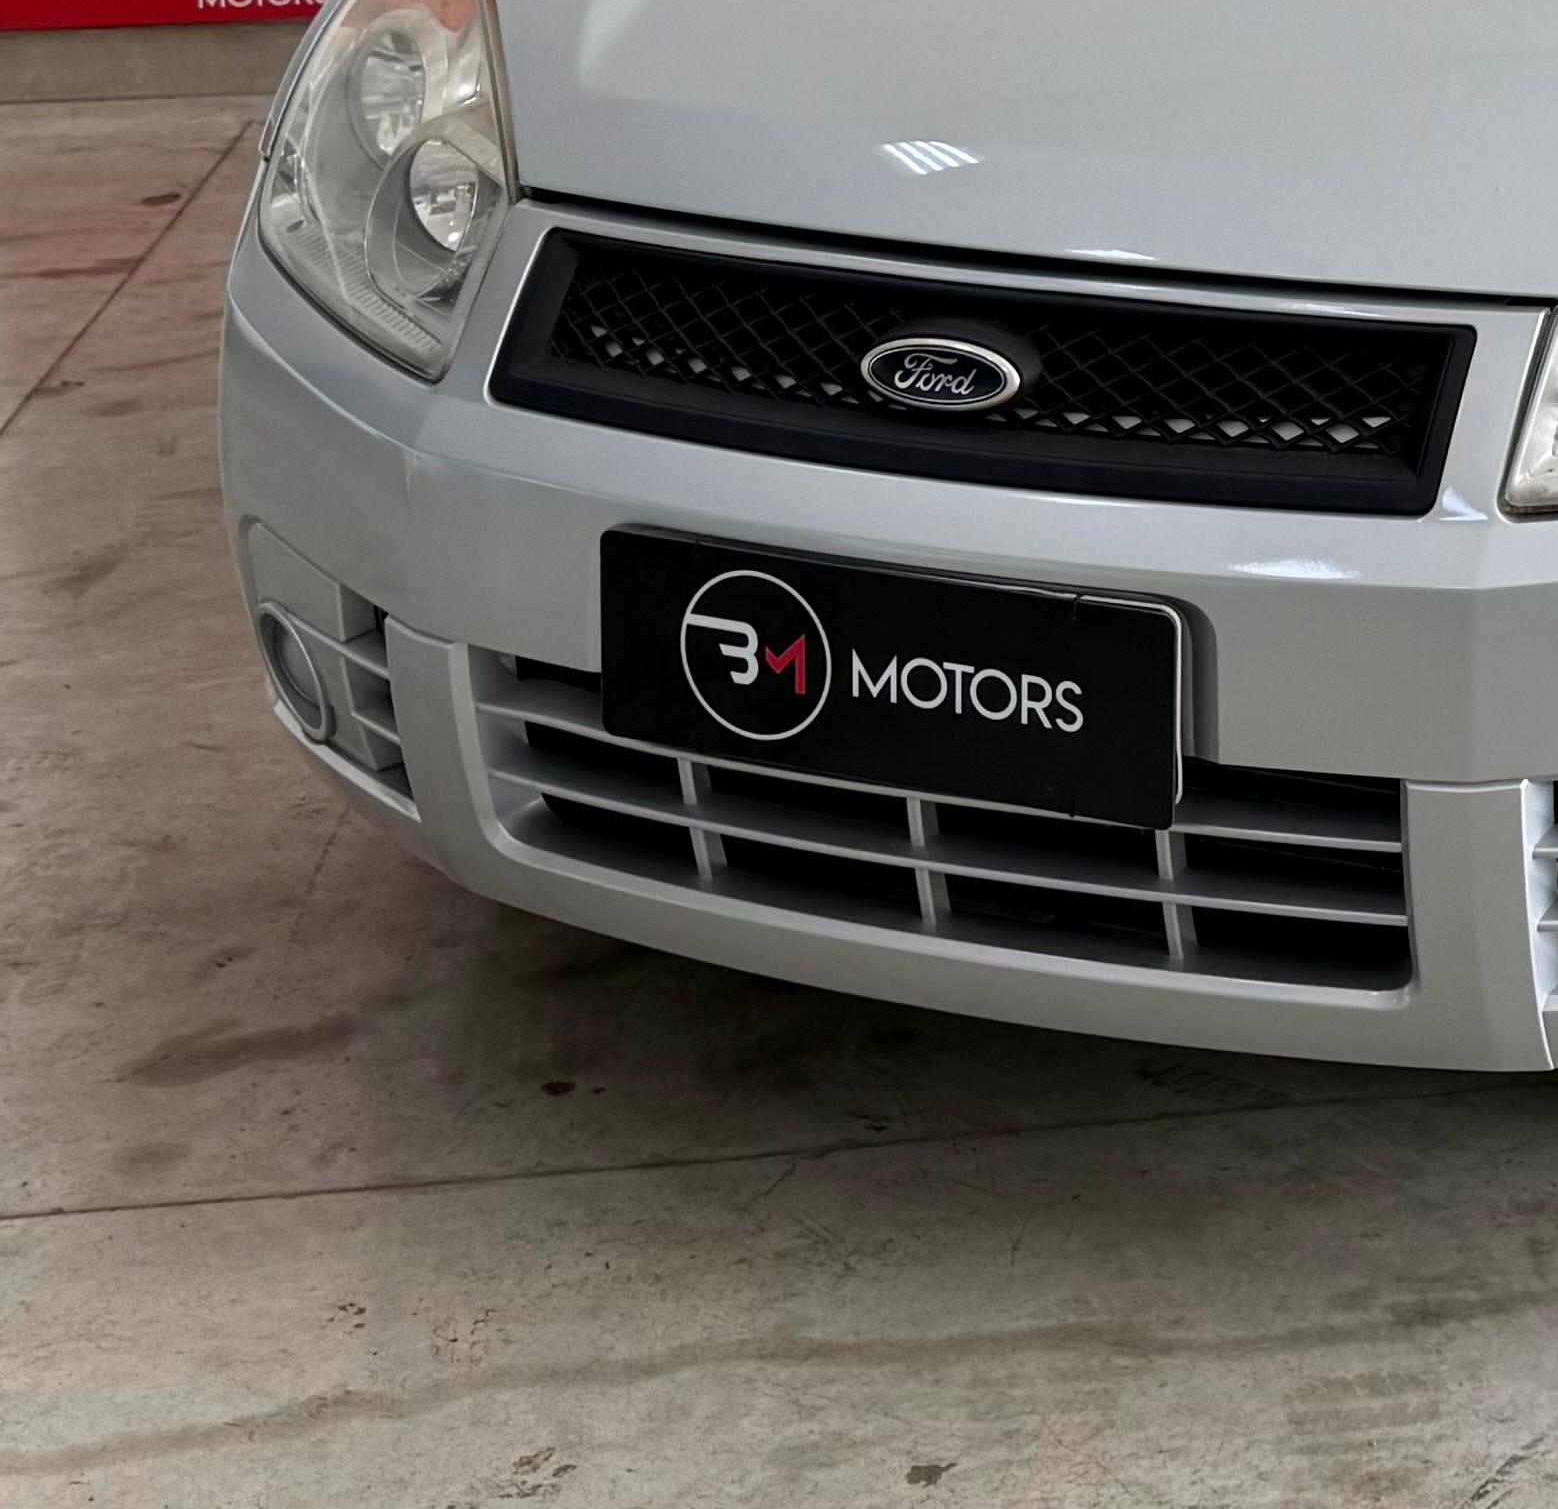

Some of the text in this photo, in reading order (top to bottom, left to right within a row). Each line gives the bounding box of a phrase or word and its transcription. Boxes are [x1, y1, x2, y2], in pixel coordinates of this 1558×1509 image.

[894, 352, 978, 396] Ford
[685, 612, 1084, 733] BM MOTORS
